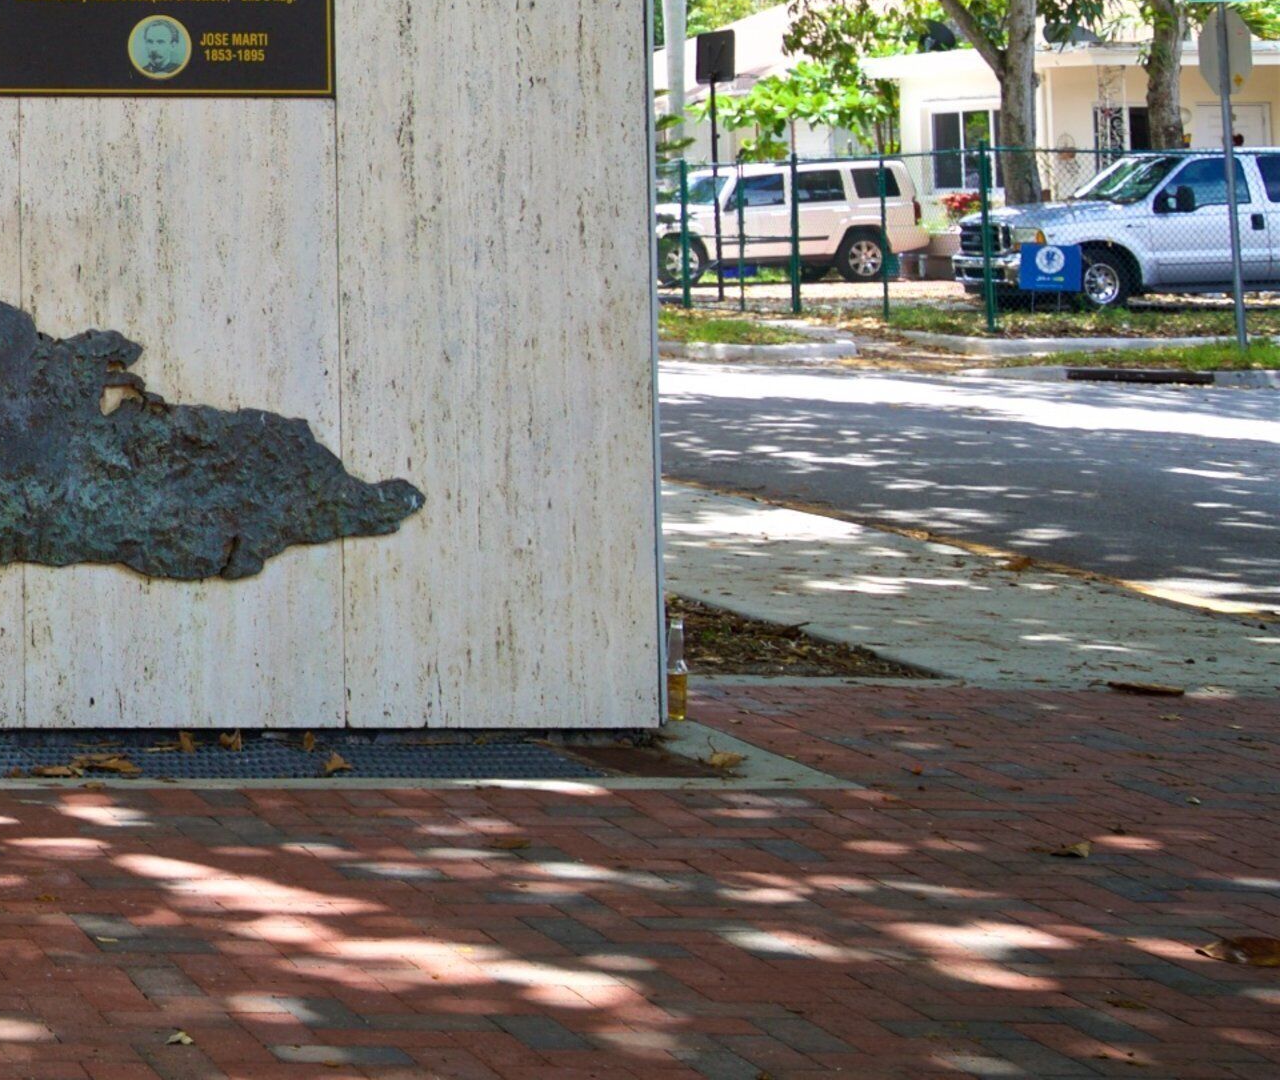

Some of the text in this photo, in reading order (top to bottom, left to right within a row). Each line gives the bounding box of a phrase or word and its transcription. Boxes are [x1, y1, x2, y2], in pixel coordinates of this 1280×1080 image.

[200, 32, 269, 47] JOSE MARTI
[204, 48, 265, 62] 1853-1895
